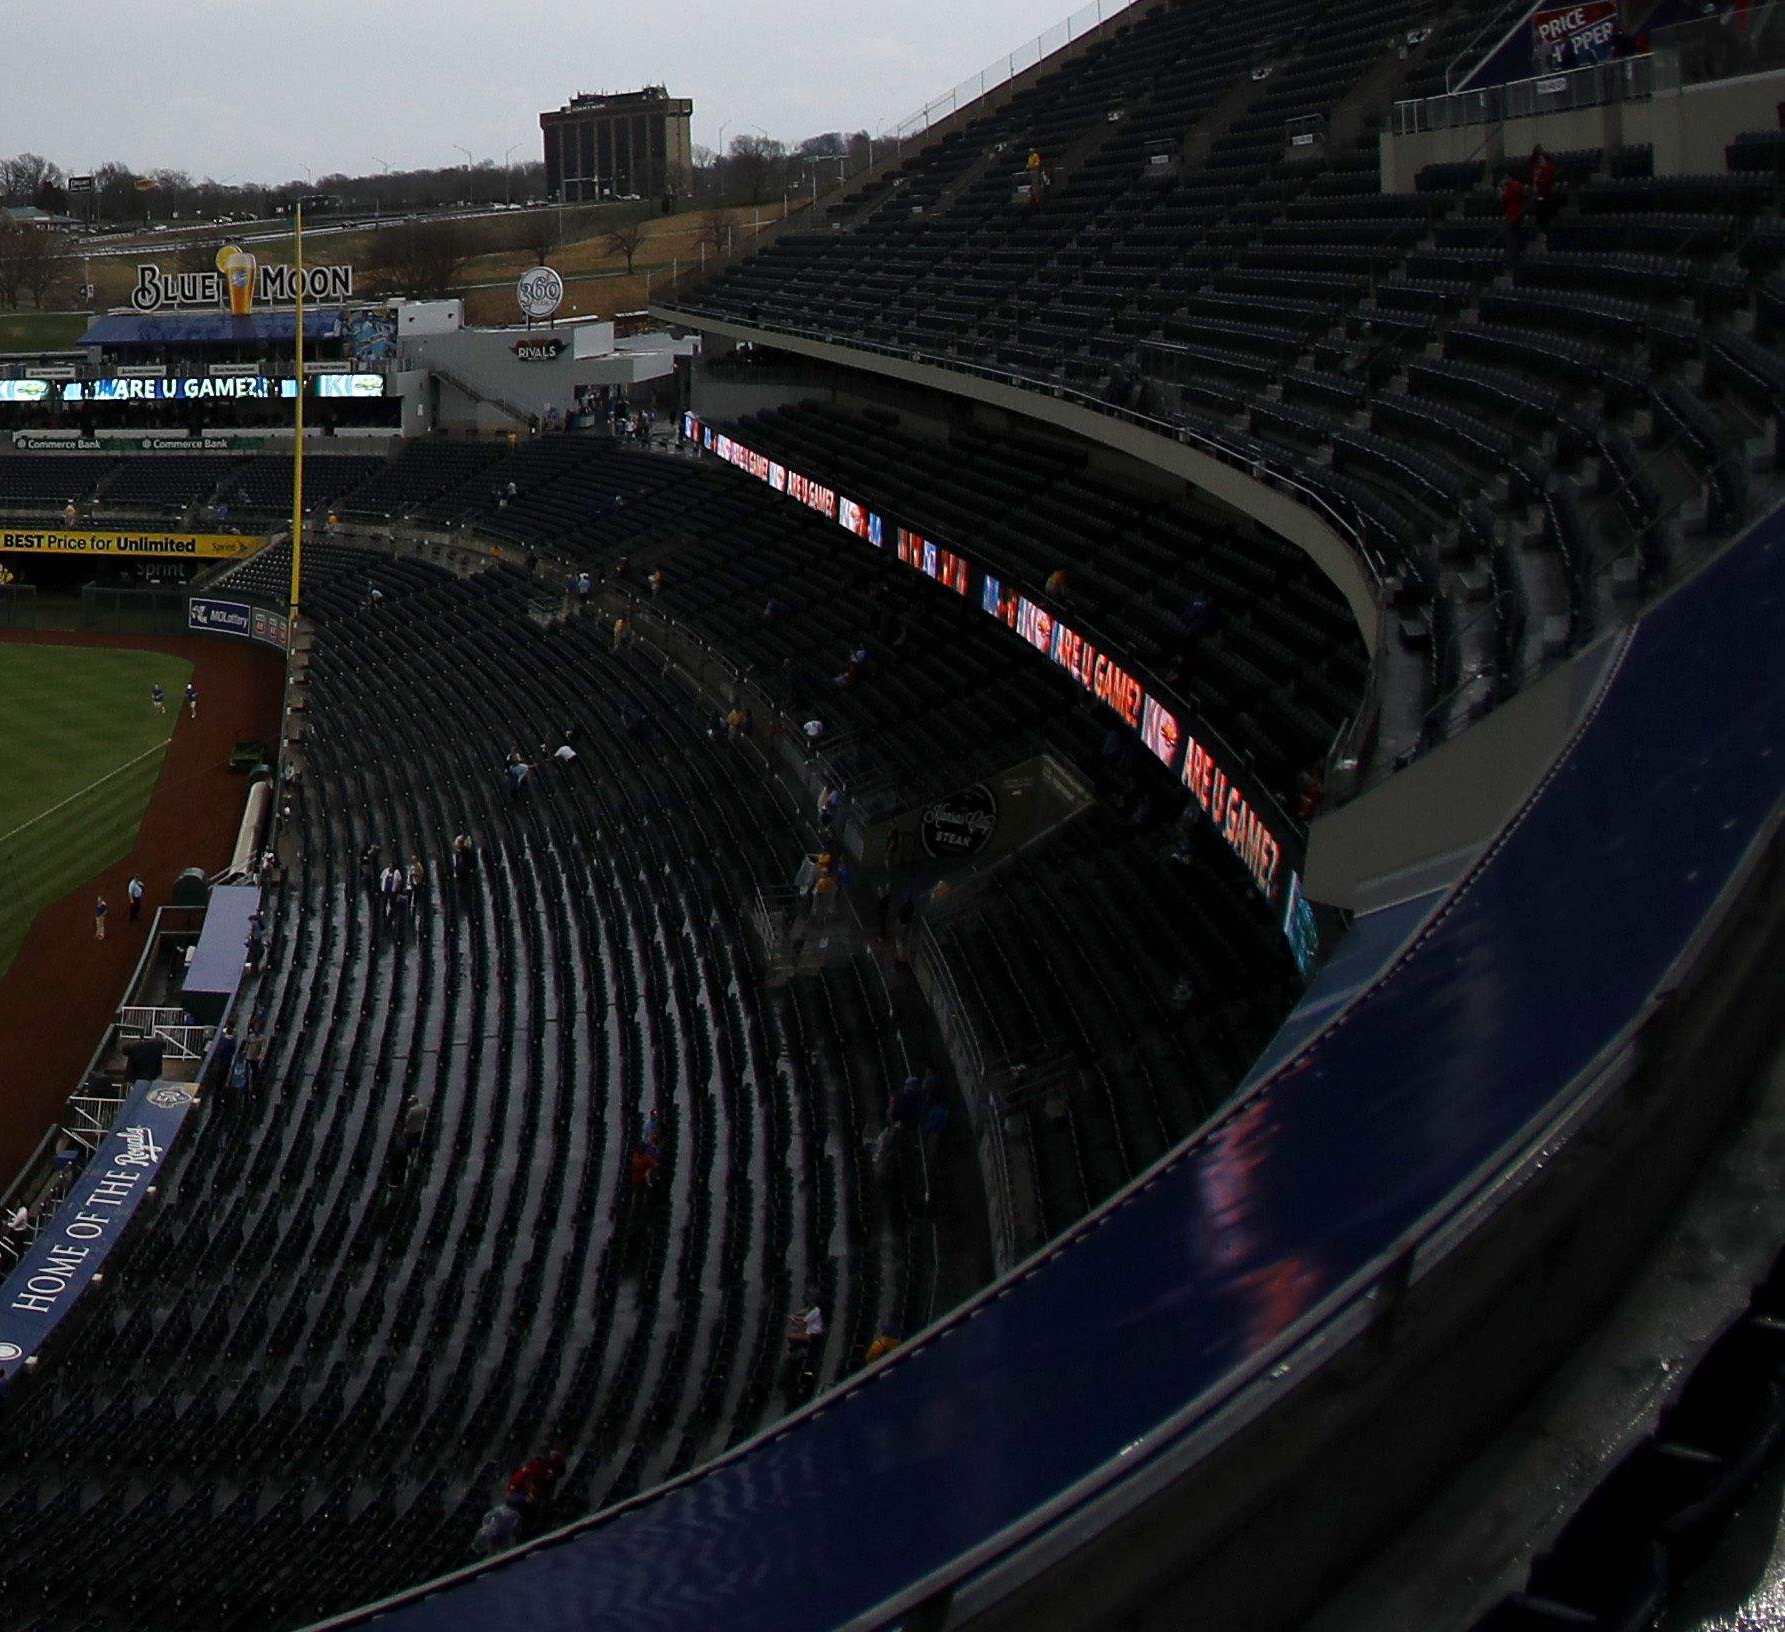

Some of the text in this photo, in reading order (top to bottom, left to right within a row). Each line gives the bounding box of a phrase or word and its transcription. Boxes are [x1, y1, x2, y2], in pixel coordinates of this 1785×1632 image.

[1539, 8, 1586, 40] PRICE
[520, 276, 560, 308] 360
[518, 346, 556, 358] RIVALS
[116, 377, 257, 398] ARE U GAME?
[28, 439, 101, 449] Commerce Bank
[153, 439, 228, 449] Commerce Bank
[3, 535, 44, 549] BEST
[48, 535, 85, 550] Price
[90, 536, 112, 550] for
[117, 537, 196, 553] Unlimited
[934, 831, 972, 847] STEAK
[11, 1125, 163, 1313] HOME OF THE Royals
